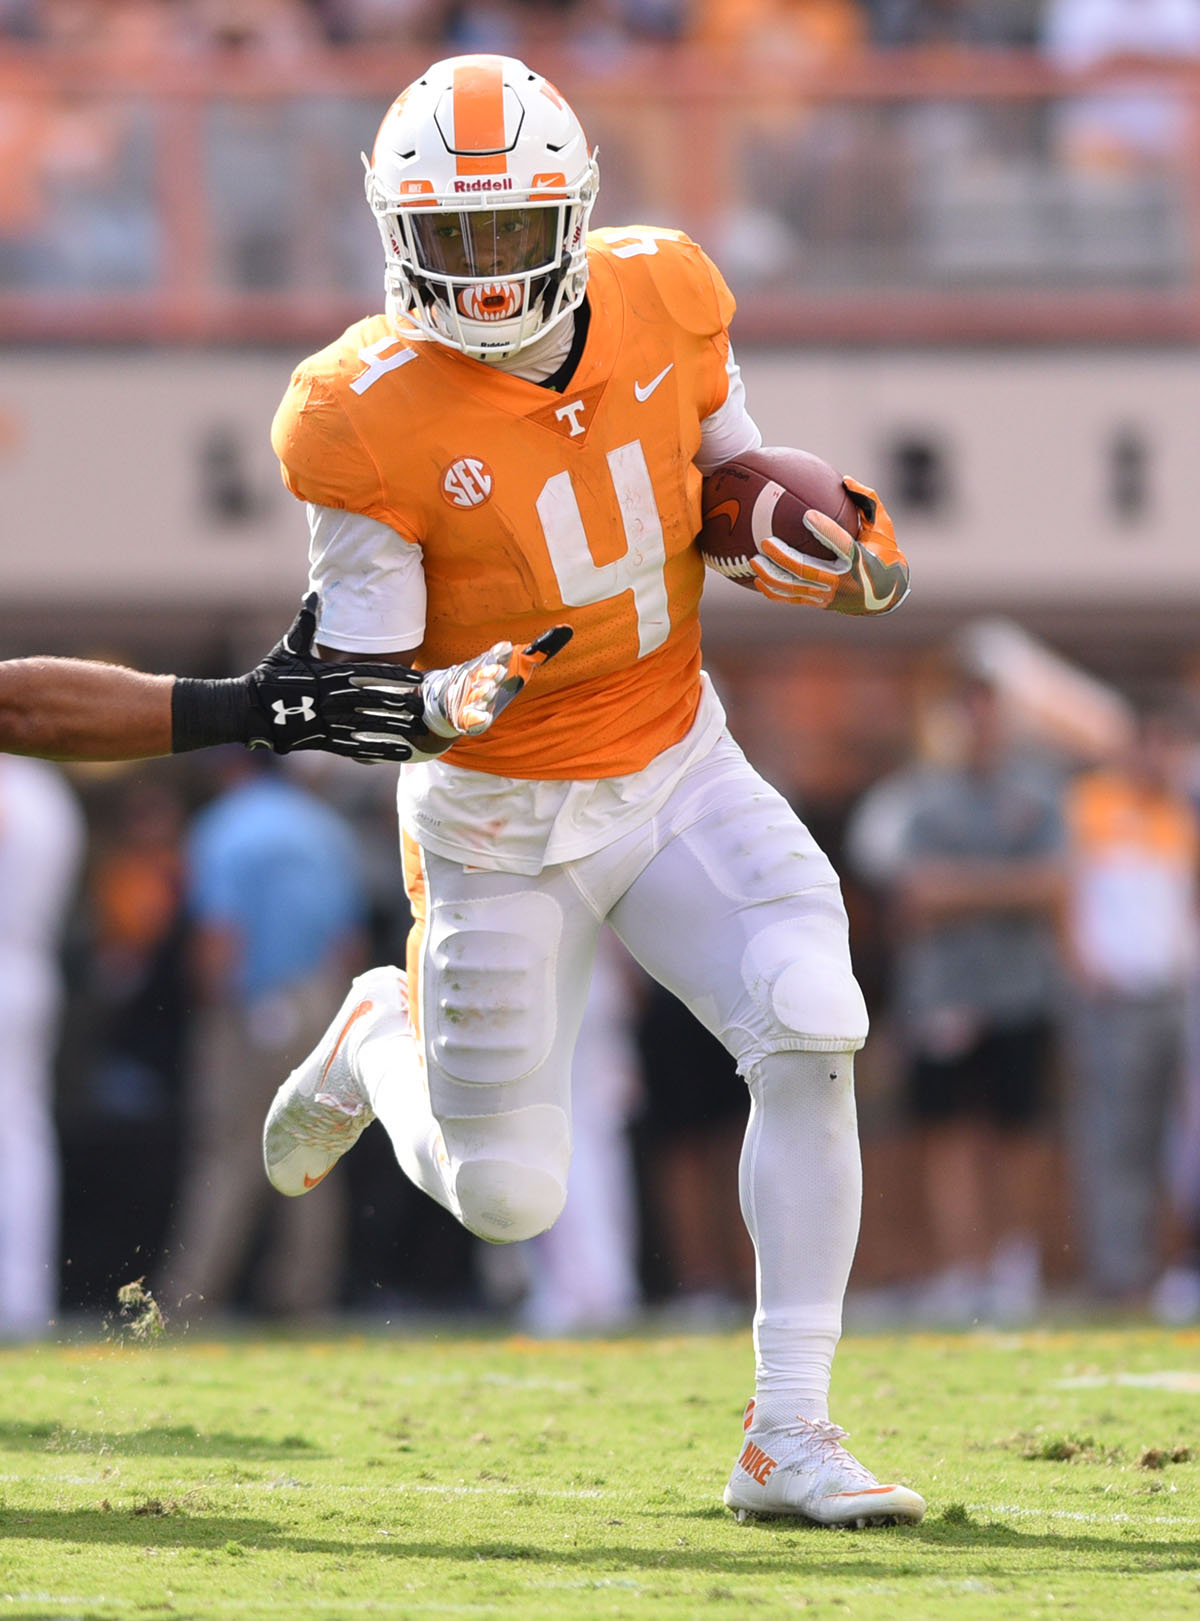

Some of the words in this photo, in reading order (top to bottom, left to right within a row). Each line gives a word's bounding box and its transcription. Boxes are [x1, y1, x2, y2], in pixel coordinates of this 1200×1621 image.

[454, 178, 512, 192] Riddell
[349, 336, 418, 395] 4
[555, 400, 586, 437] T
[444, 458, 492, 506] SEC
[535, 439, 671, 659] 4
[738, 1440, 779, 1487] NIKE
